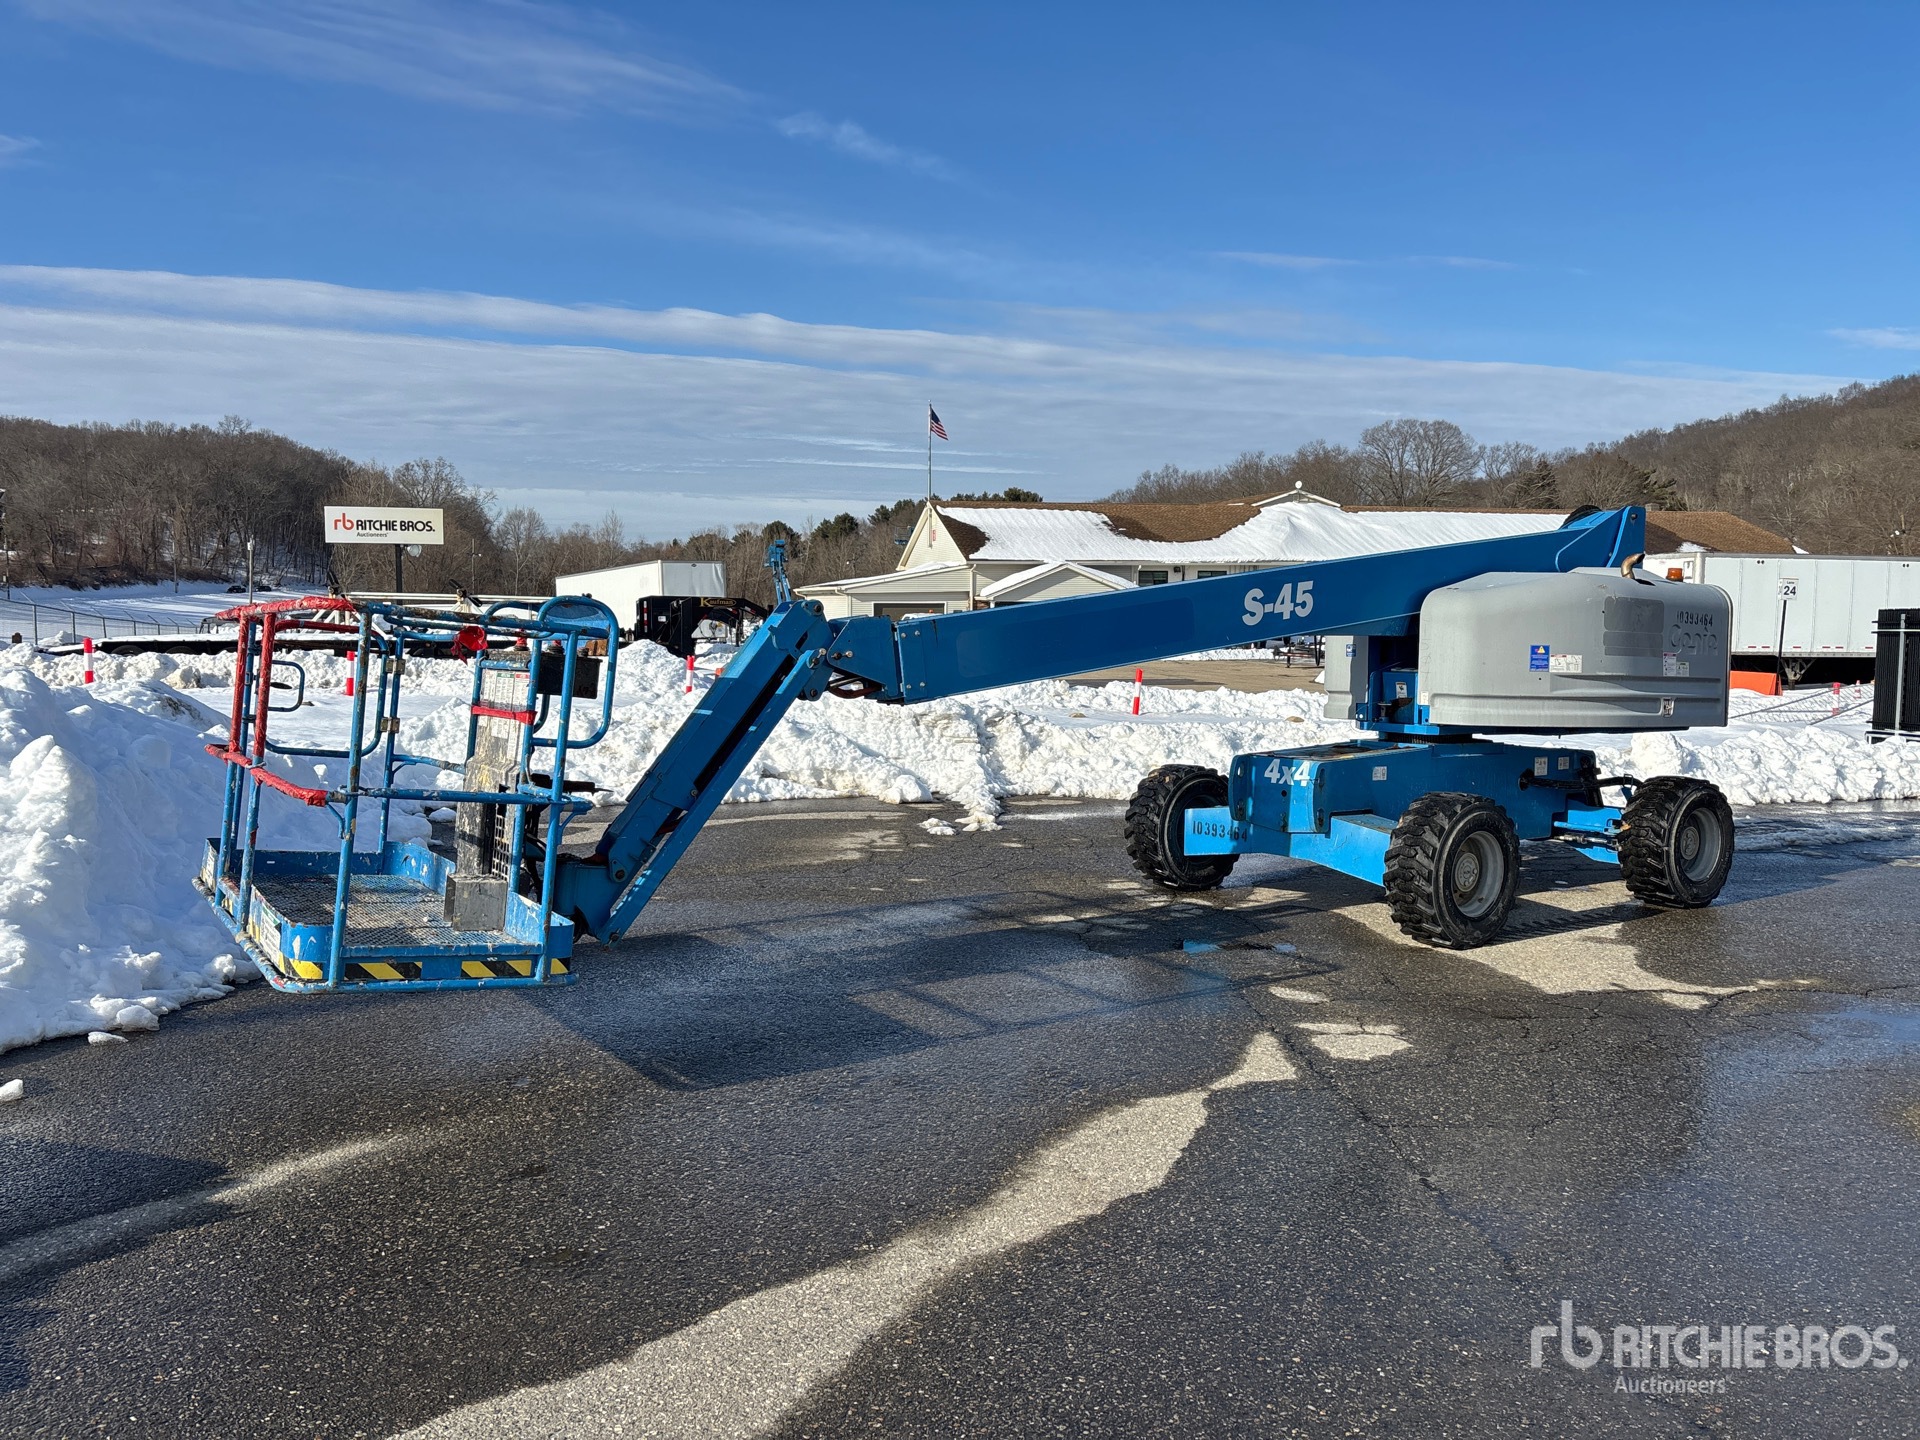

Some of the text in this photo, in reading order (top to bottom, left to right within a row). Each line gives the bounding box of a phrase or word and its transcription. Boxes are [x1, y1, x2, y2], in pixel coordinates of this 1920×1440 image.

[333, 512, 435, 532] rb RITCHIE BROS.
[1783, 585, 1796, 596] 24
[1241, 580, 1314, 626] S-45
[1676, 610, 1713, 627] 10393464
[1192, 820, 1247, 843] 10393464
